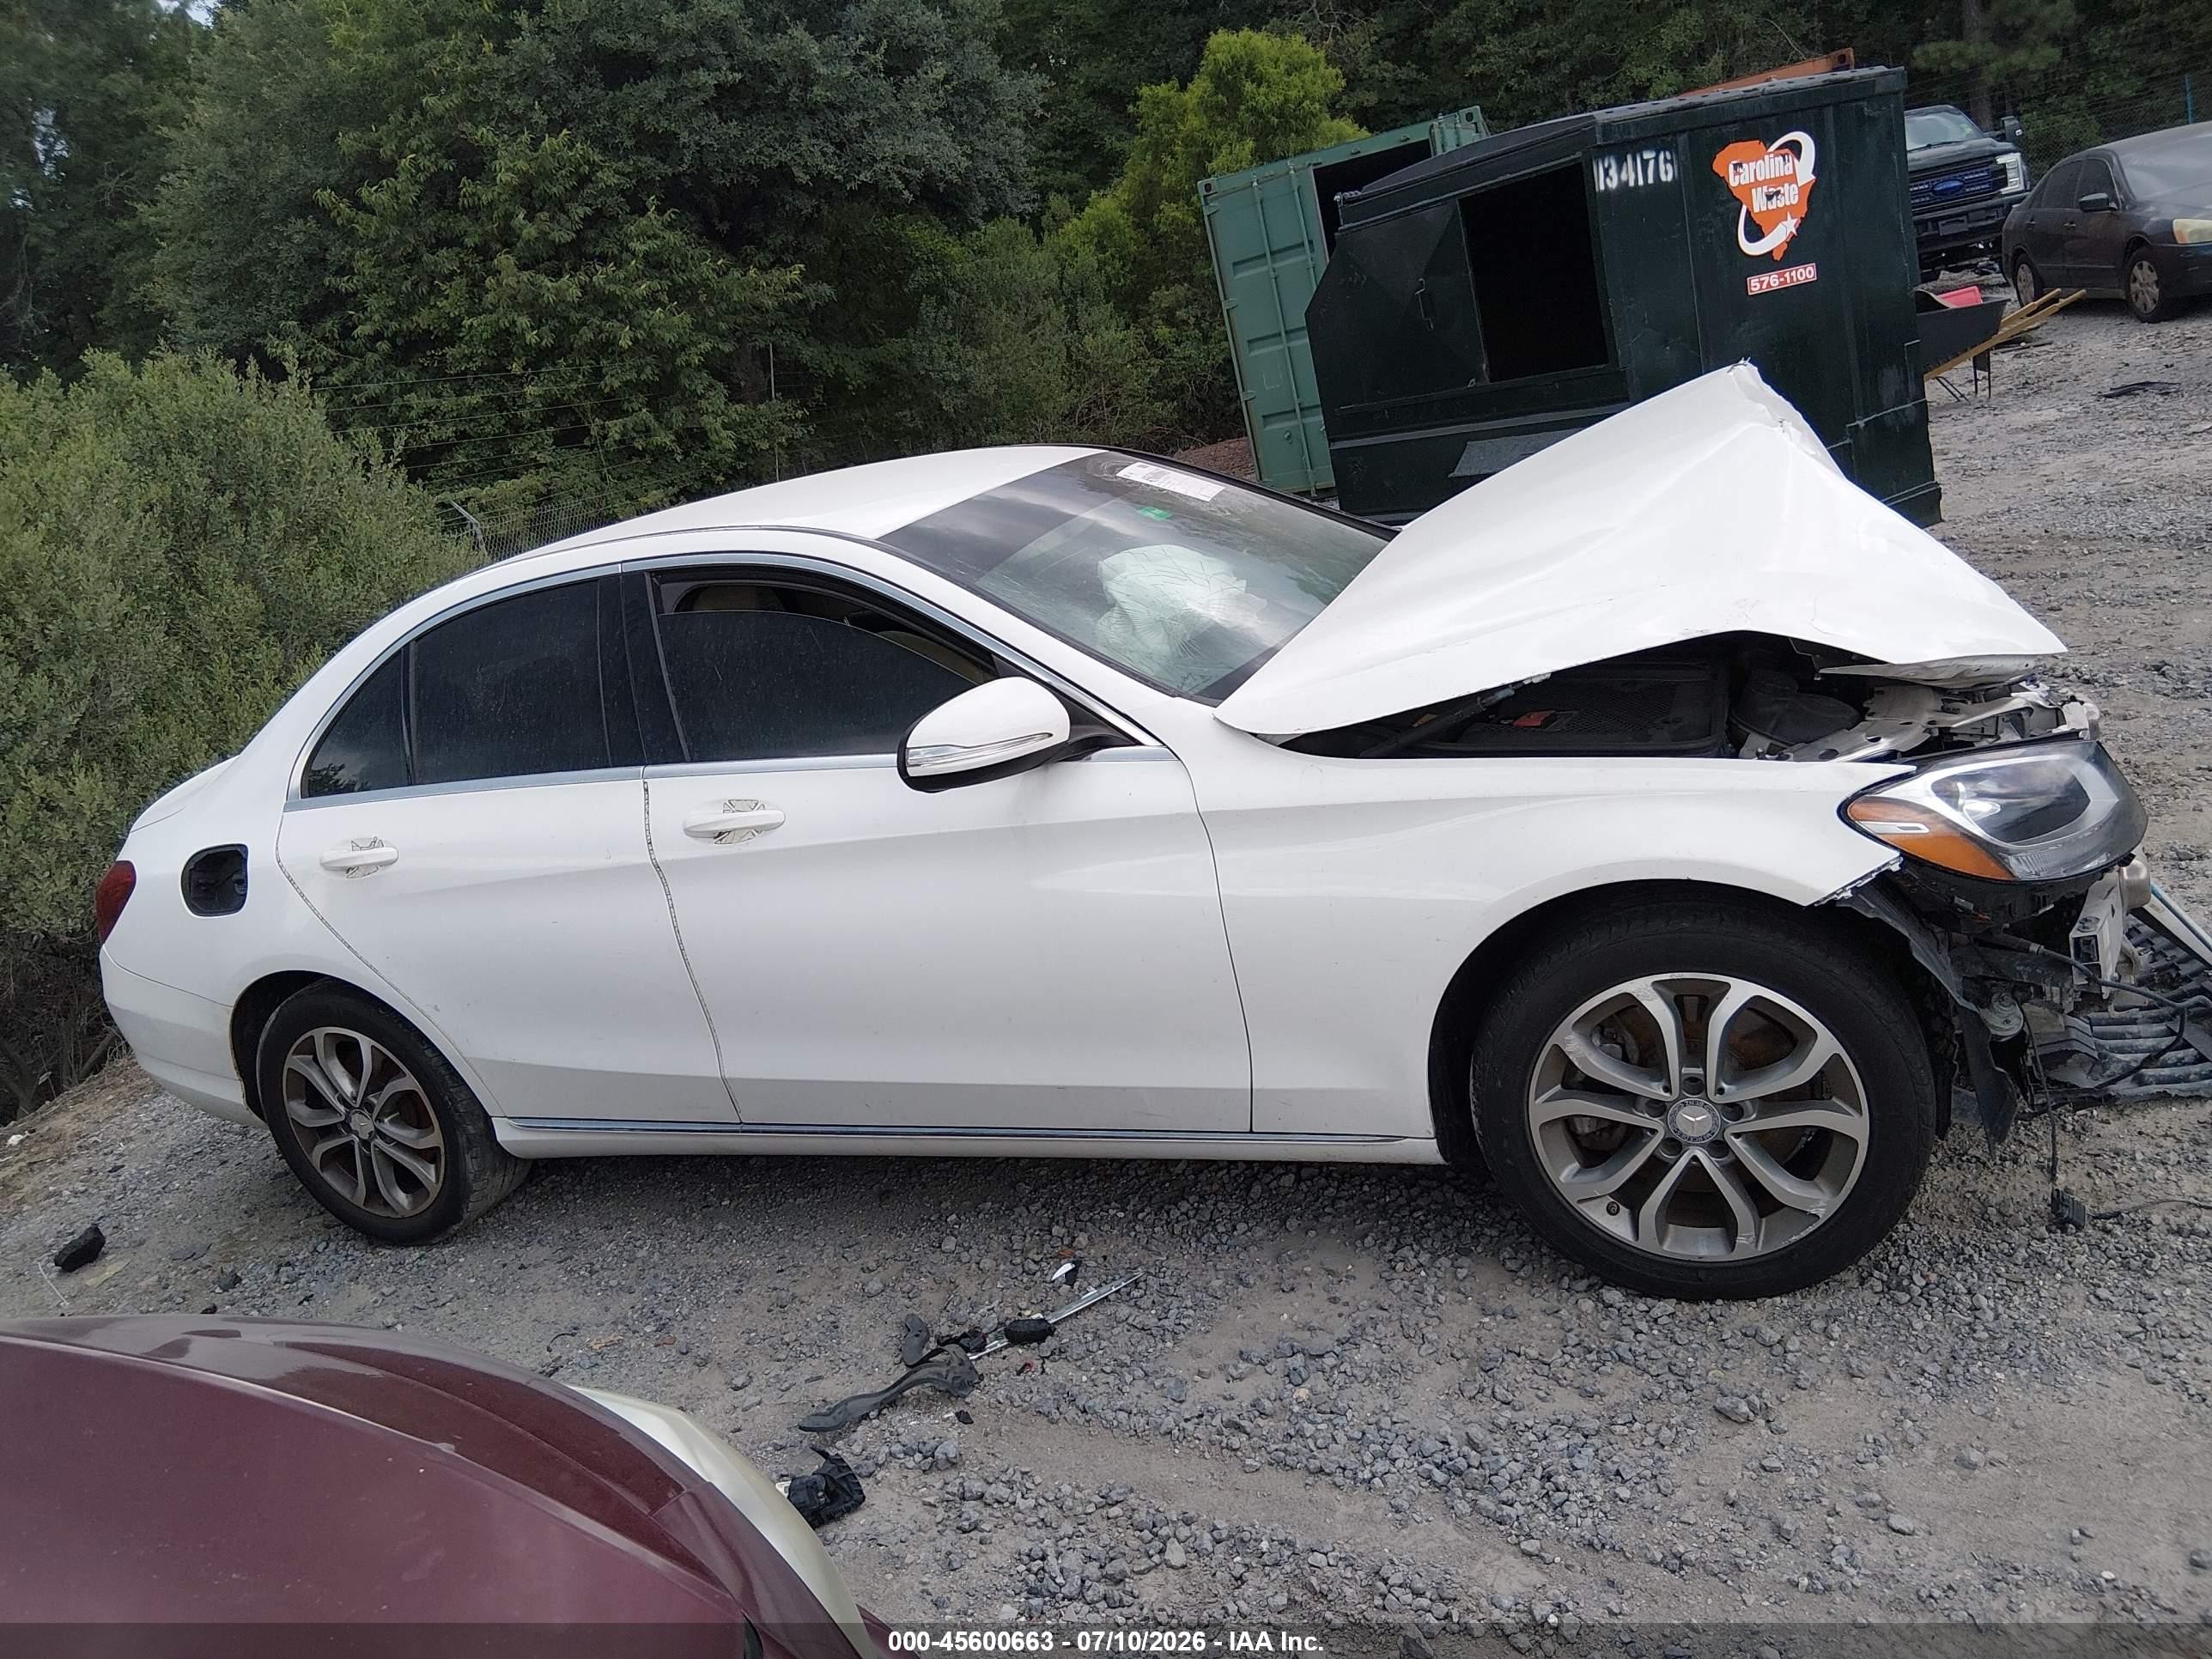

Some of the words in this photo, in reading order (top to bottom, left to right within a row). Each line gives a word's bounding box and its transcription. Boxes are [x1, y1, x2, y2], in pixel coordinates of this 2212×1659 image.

[1728, 153, 1794, 187] Carolina
[1750, 182, 1800, 214] Waste
[1749, 265, 1814, 292] 576-1100
